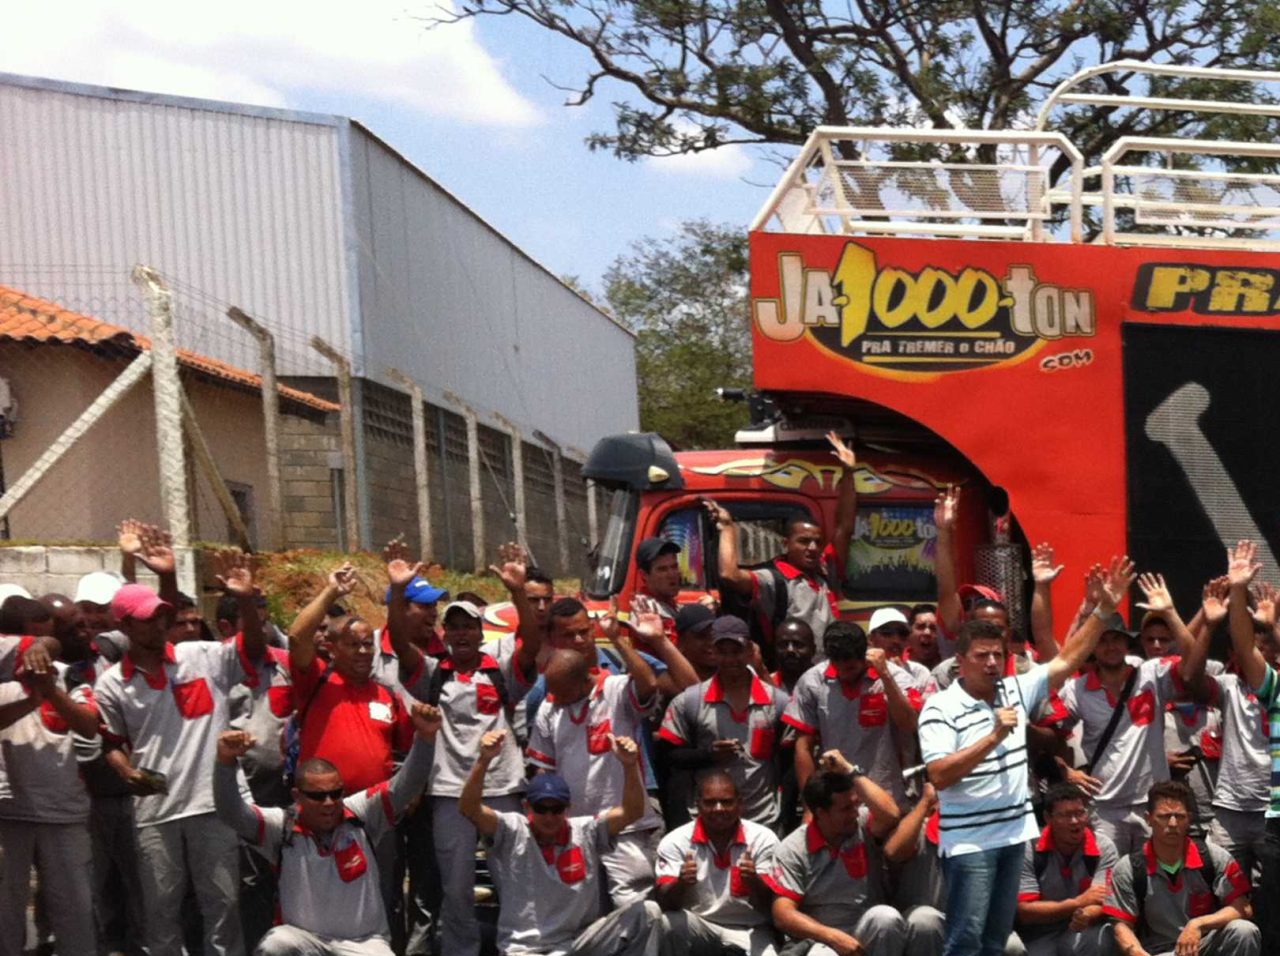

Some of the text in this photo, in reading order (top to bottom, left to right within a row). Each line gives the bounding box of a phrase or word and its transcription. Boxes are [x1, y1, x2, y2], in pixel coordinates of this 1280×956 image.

[861, 340, 892, 354] PRA
[898, 340, 955, 354] TREMER
[974, 338, 1016, 354] CHÃO
